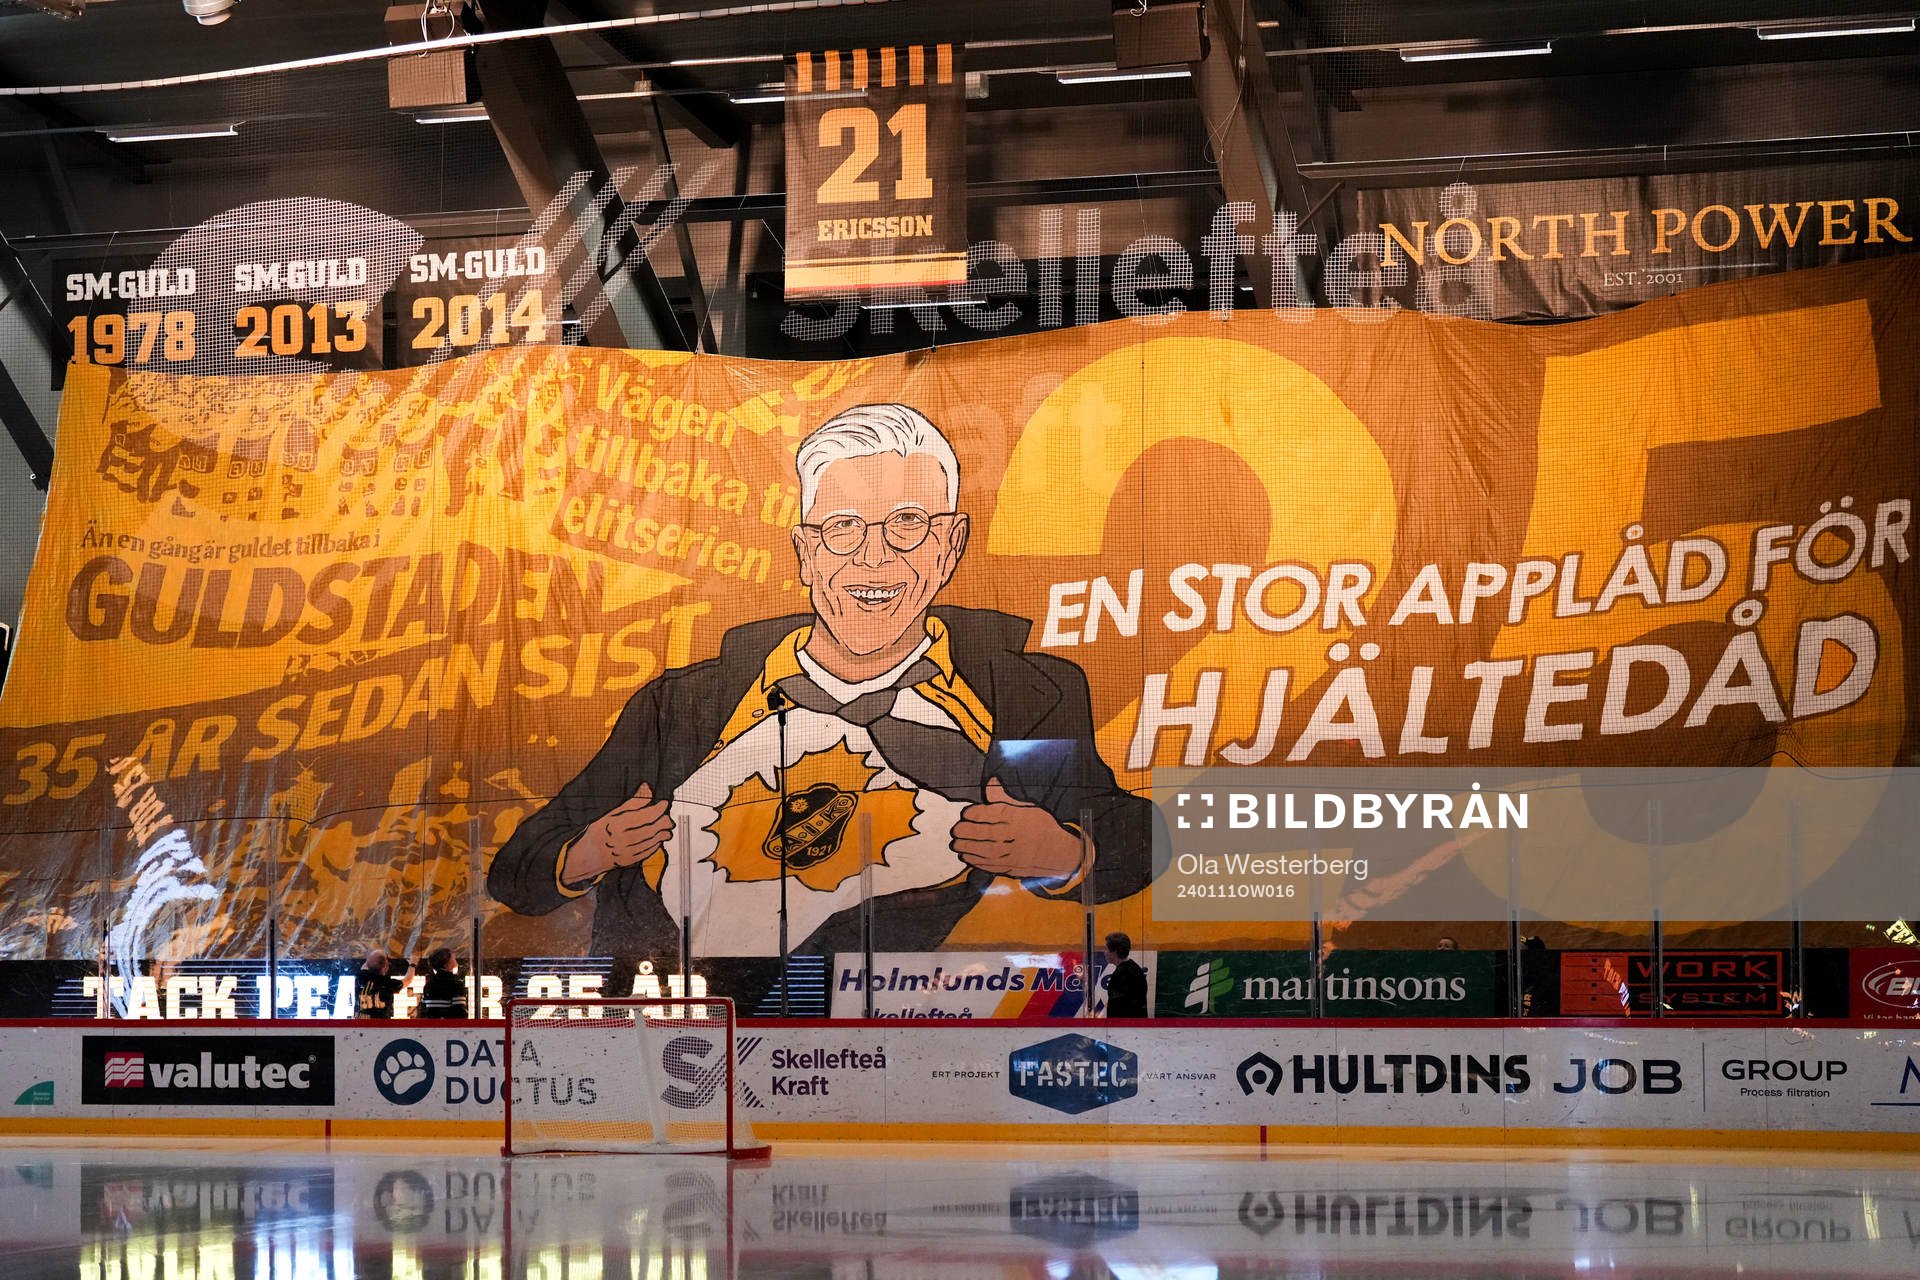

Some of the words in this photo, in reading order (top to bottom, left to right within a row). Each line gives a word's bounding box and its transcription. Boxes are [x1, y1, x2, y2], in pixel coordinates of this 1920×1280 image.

[816, 102, 934, 204] 21
[816, 213, 934, 242] ERICSSON
[1378, 209, 1630, 267] NORTH
[1651, 196, 1913, 256] POWER
[234, 256, 368, 293] SM-GULD
[409, 246, 546, 284] SM-GULD
[1603, 271, 1643, 289] EST.
[1646, 272, 1684, 286] 2001
[66, 267, 197, 302] SM-GULD
[67, 310, 196, 365] 1978
[234, 301, 368, 358] 2013
[410, 289, 548, 350] 2014
[595, 363, 738, 449] Vägen
[574, 424, 749, 516] tillbaka
[763, 482, 803, 529] ti
[149, 536, 200, 564] gång
[229, 538, 293, 564] guldet
[296, 530, 371, 555] tillbaka
[1040, 568, 1145, 649] EN
[1162, 560, 1373, 634] STOR
[1387, 523, 1727, 628] APPLÅD
[1751, 495, 1913, 593] FÖR
[65, 540, 606, 650] GULDSTADEN
[4, 731, 107, 806] 35
[130, 714, 238, 784] ÅR
[242, 640, 504, 763] SEDAN
[513, 600, 712, 699] SIST
[1125, 606, 1882, 772] HJÄLTEDÅD
[839, 967, 1026, 992] Holmlunds
[1031, 964, 1113, 992] Måle
[1241, 967, 1467, 1001] martinsons
[1636, 961, 1770, 978] WORK
[82, 975, 240, 1020] TACK
[525, 975, 606, 1020] 25
[626, 960, 709, 1020] ÅR
[149, 1051, 310, 1089] valutec
[445, 1039, 540, 1067] DATA
[771, 1046, 887, 1070] Skellefteå
[1722, 1059, 1848, 1082] GROUP
[445, 1076, 598, 1105] DUCTUS
[771, 1075, 829, 1097] Kraft
[954, 1072, 1000, 1080] PROJEKT
[1020, 1060, 1128, 1088] FASTEC
[1175, 1072, 1217, 1080] ANSVAR
[1293, 1054, 1531, 1094] HULTDINS
[1553, 1059, 1682, 1095] JOB
[1740, 1087, 1783, 1098] Process
[1787, 1086, 1830, 1098] filtration
